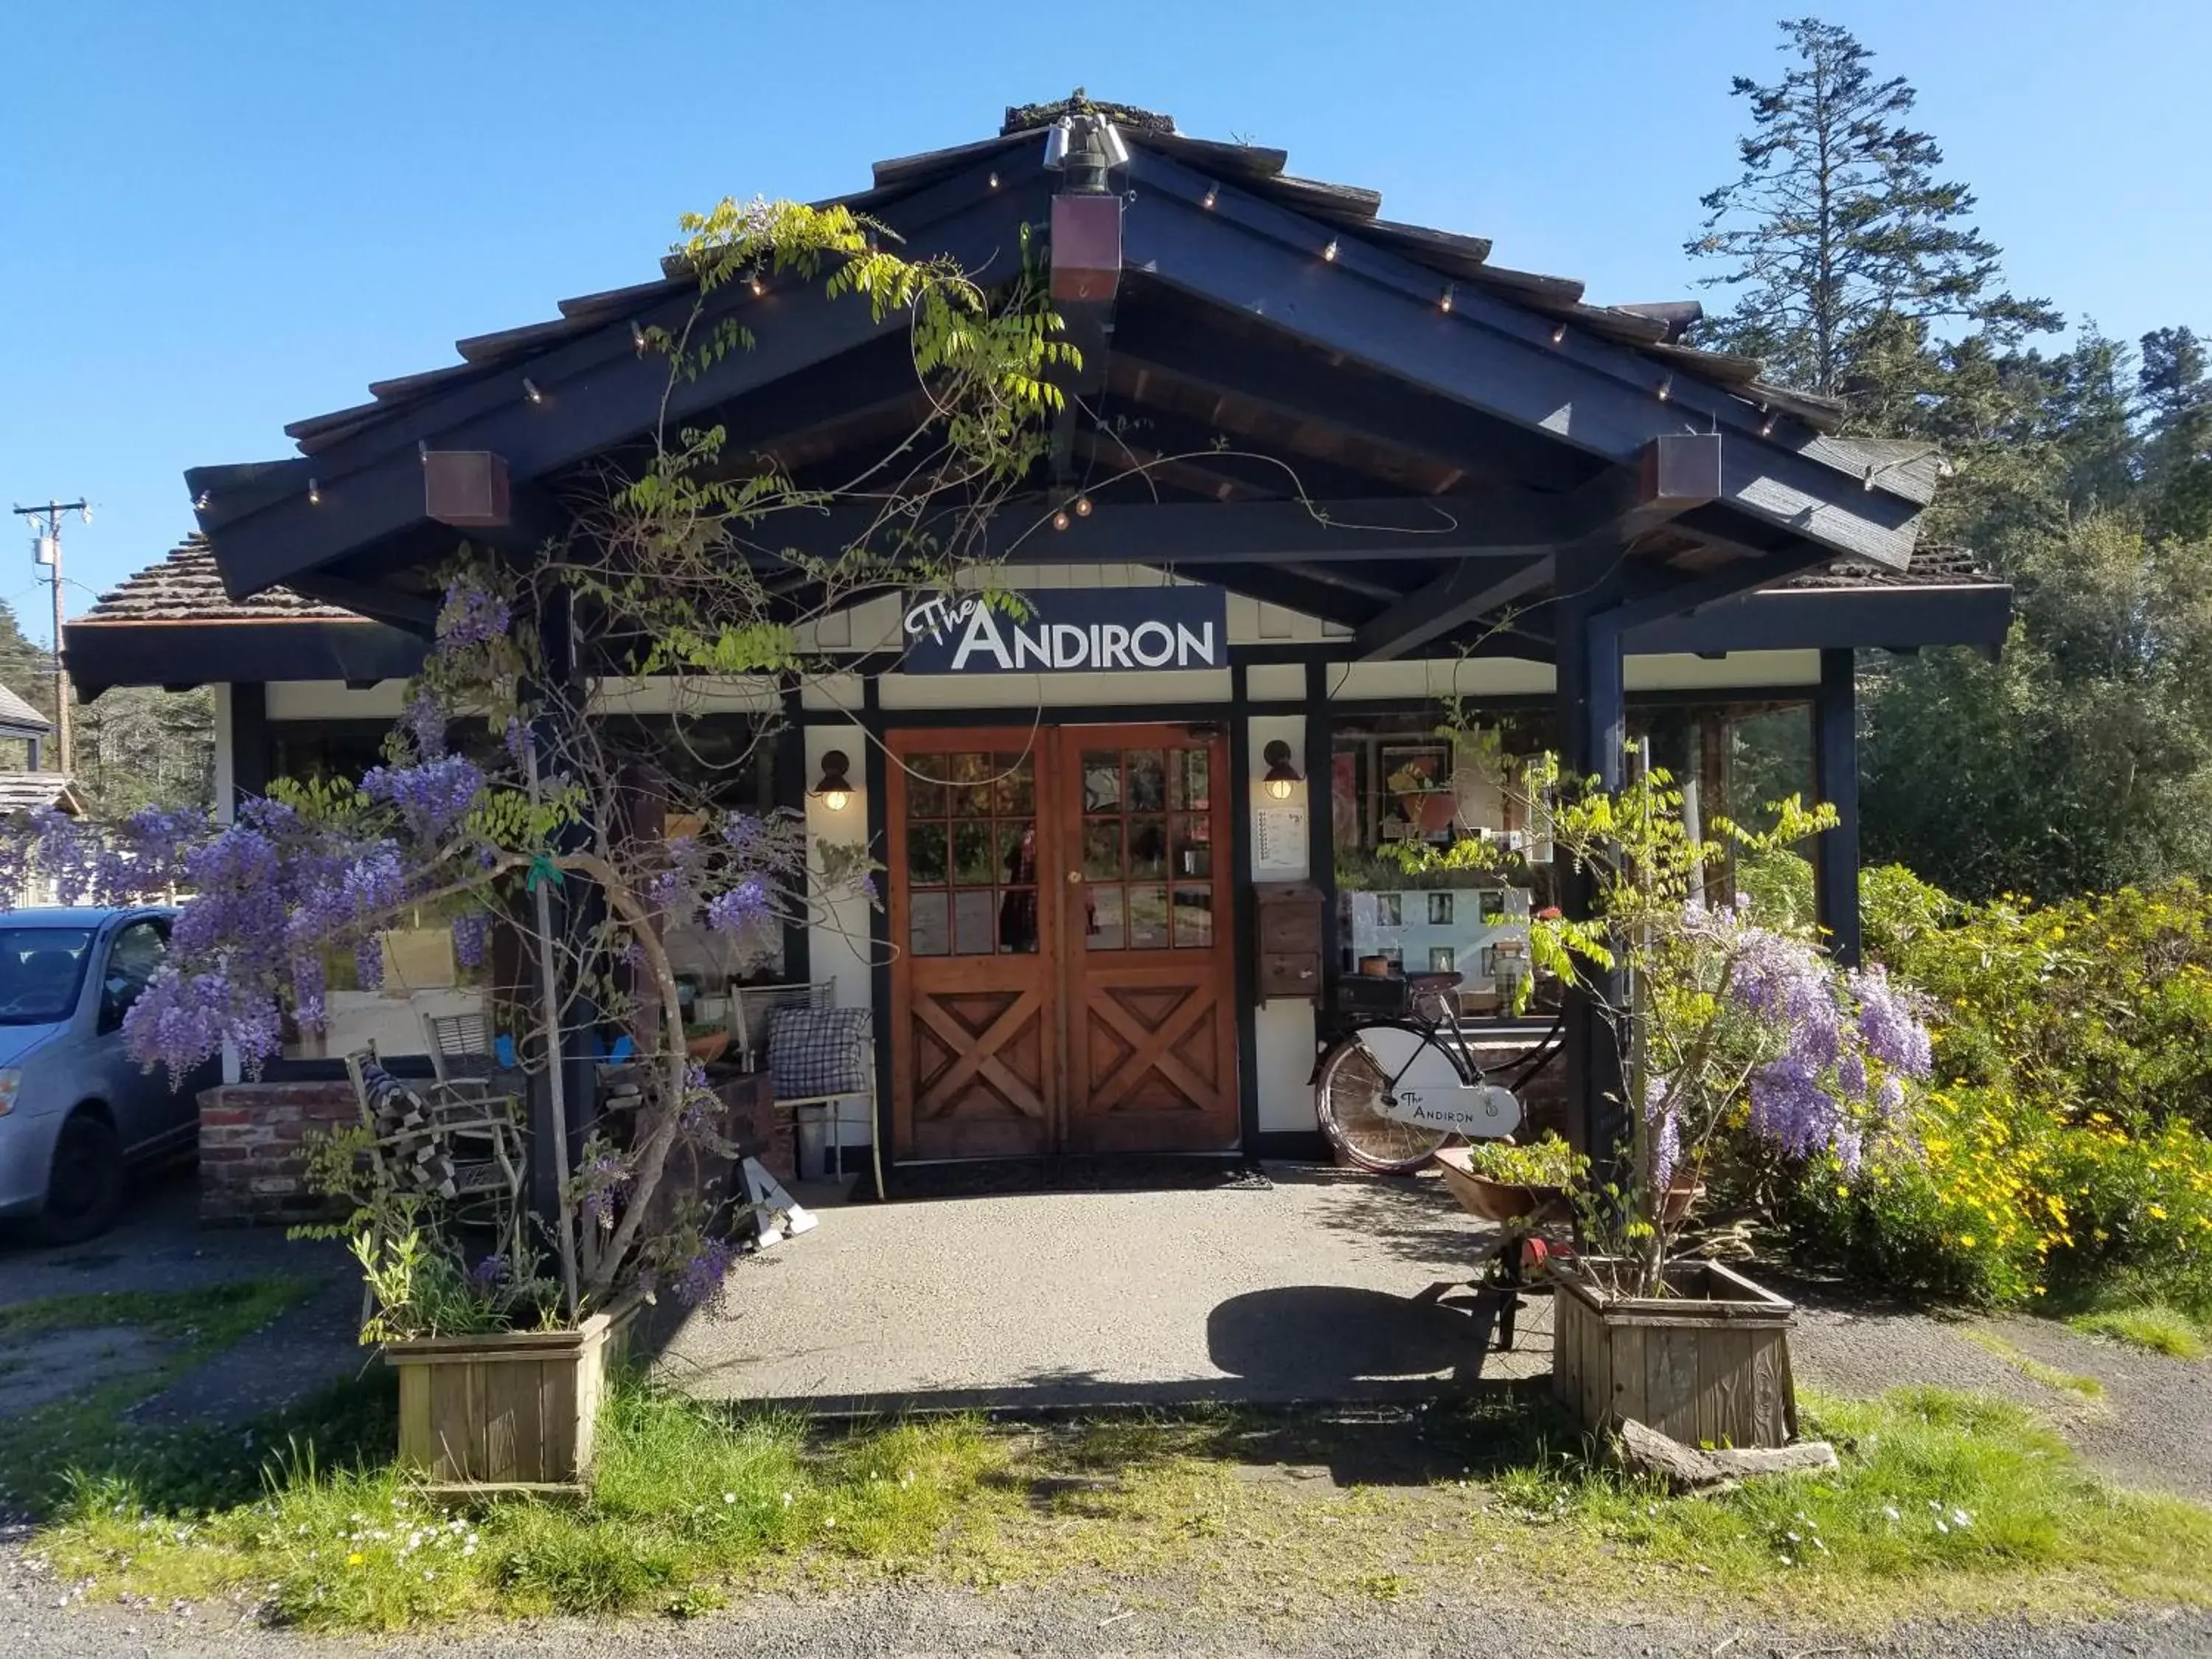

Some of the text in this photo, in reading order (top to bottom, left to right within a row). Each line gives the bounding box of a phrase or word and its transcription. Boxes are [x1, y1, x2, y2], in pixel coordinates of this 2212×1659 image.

[904, 596, 1214, 670] The ANDIRON
[1400, 1092, 1423, 1106] The
[1413, 1105, 1473, 1122] ANDIRON
[742, 1156, 819, 1248] A
